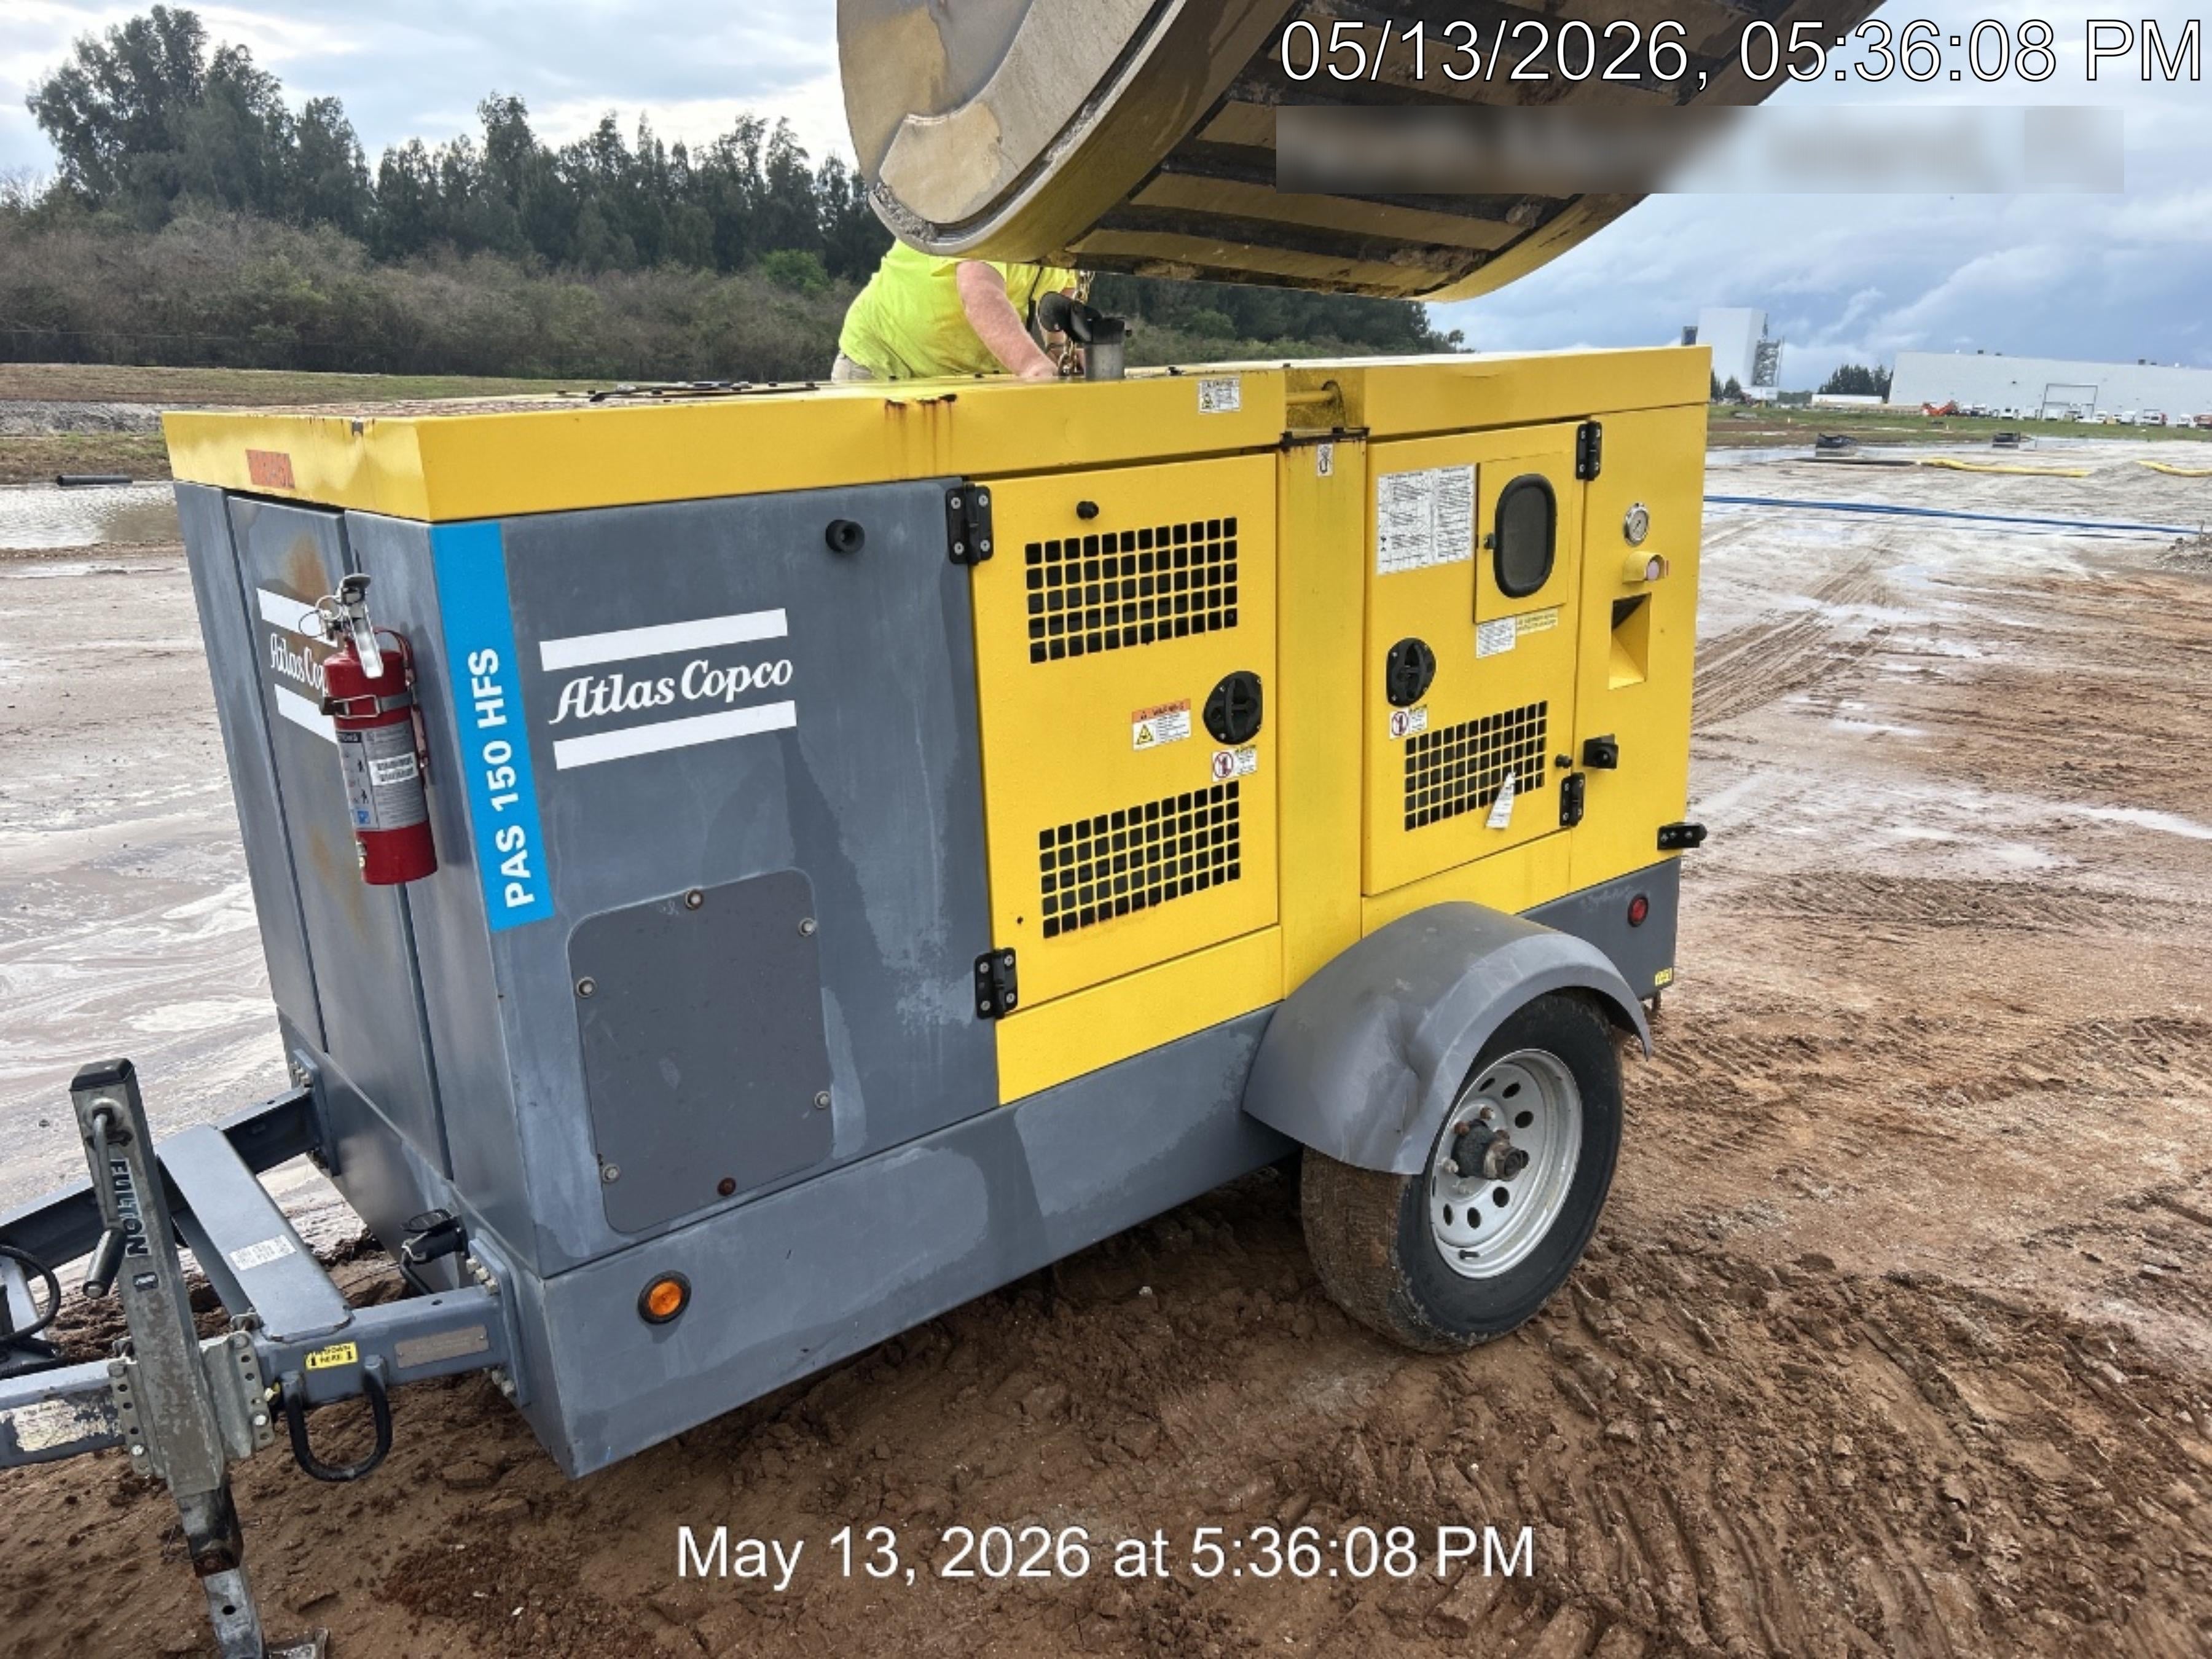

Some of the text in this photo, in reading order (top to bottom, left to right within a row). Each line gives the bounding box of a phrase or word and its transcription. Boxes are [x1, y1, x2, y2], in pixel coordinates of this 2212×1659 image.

[270, 632, 305, 683] Atlas
[548, 659, 794, 725] Atlas Copco
[468, 648, 535, 908] PAS 150 HFS
[110, 1158, 152, 1258] FULTON
